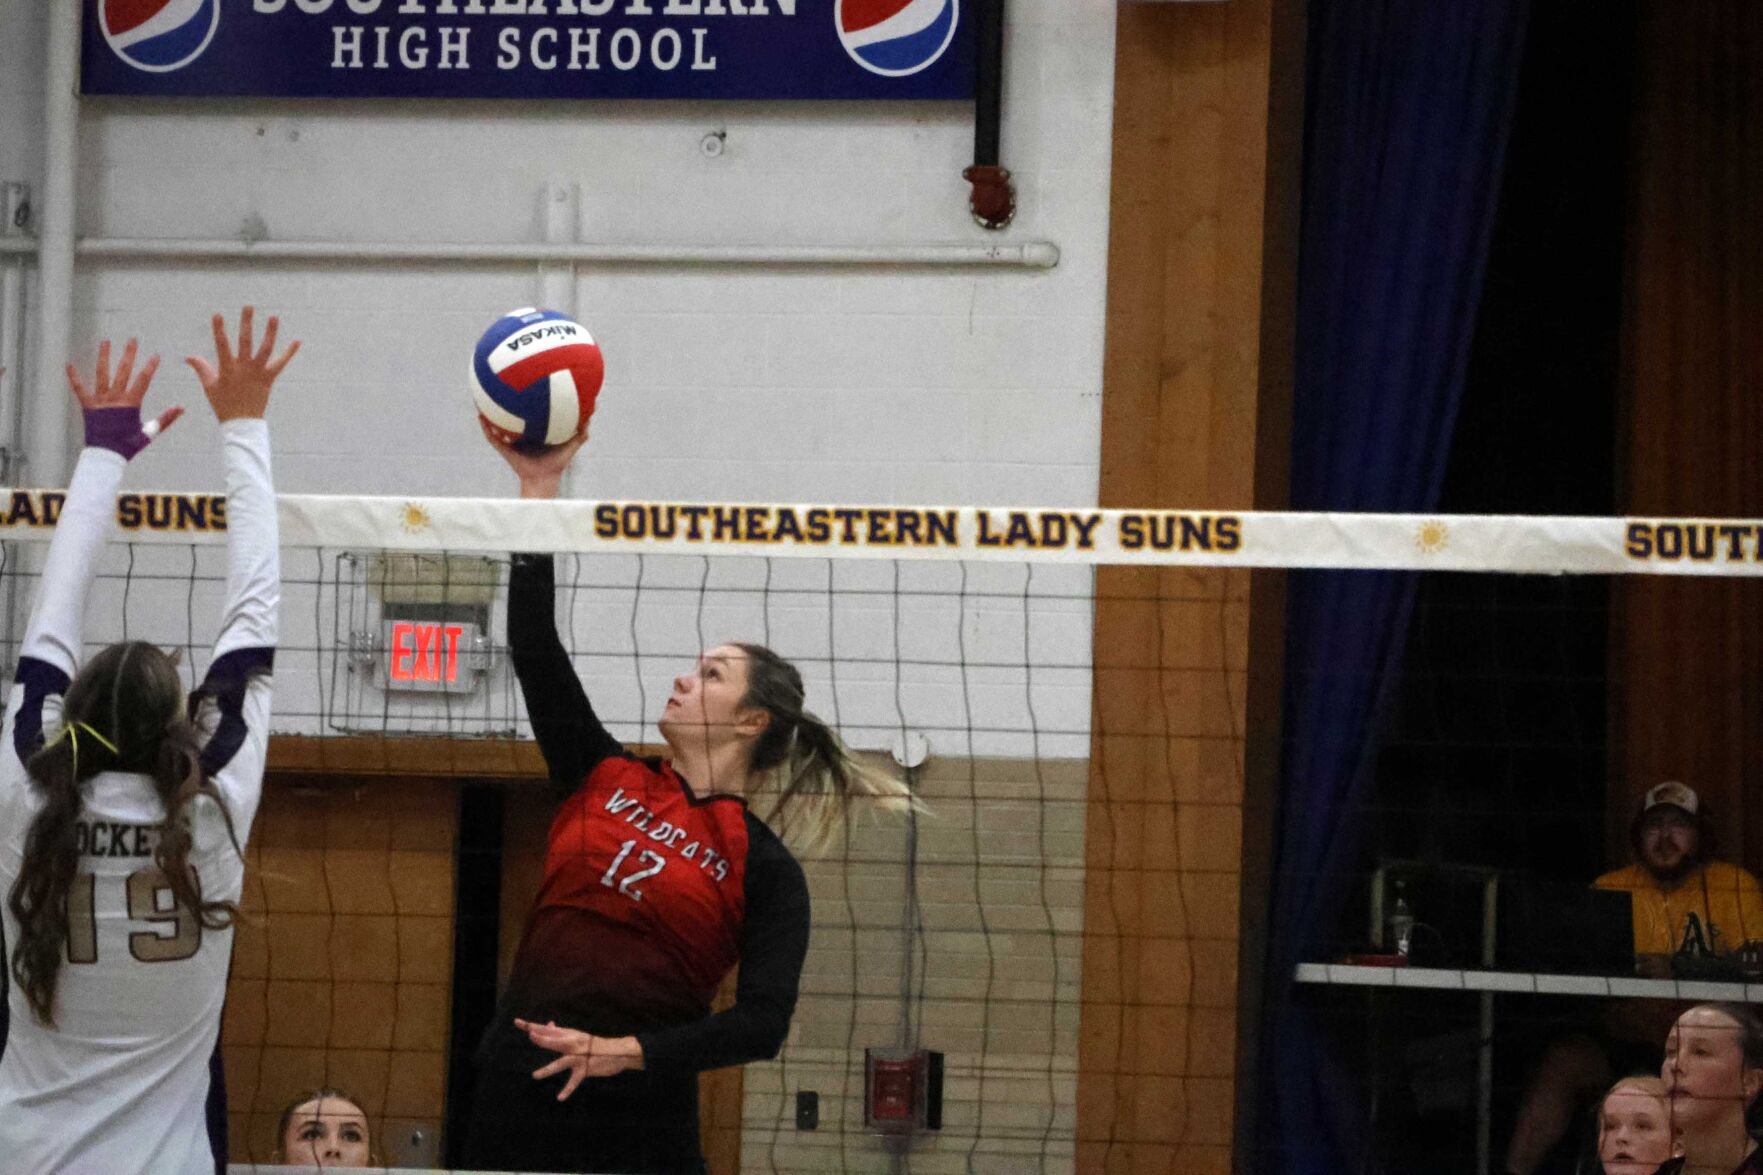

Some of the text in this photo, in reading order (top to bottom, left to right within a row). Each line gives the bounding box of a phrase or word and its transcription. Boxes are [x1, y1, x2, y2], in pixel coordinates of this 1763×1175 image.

[331, 26, 716, 71] HIGH SCHOOL
[117, 494, 228, 532] SUNS
[594, 502, 1243, 553] SOUTHEASTERN LADY SUNS
[1624, 521, 1763, 562] SOUT
[390, 622, 464, 683] EXIT
[604, 787, 730, 882] WILDCATS
[600, 839, 667, 901] 12
[66, 868, 202, 964] 19
